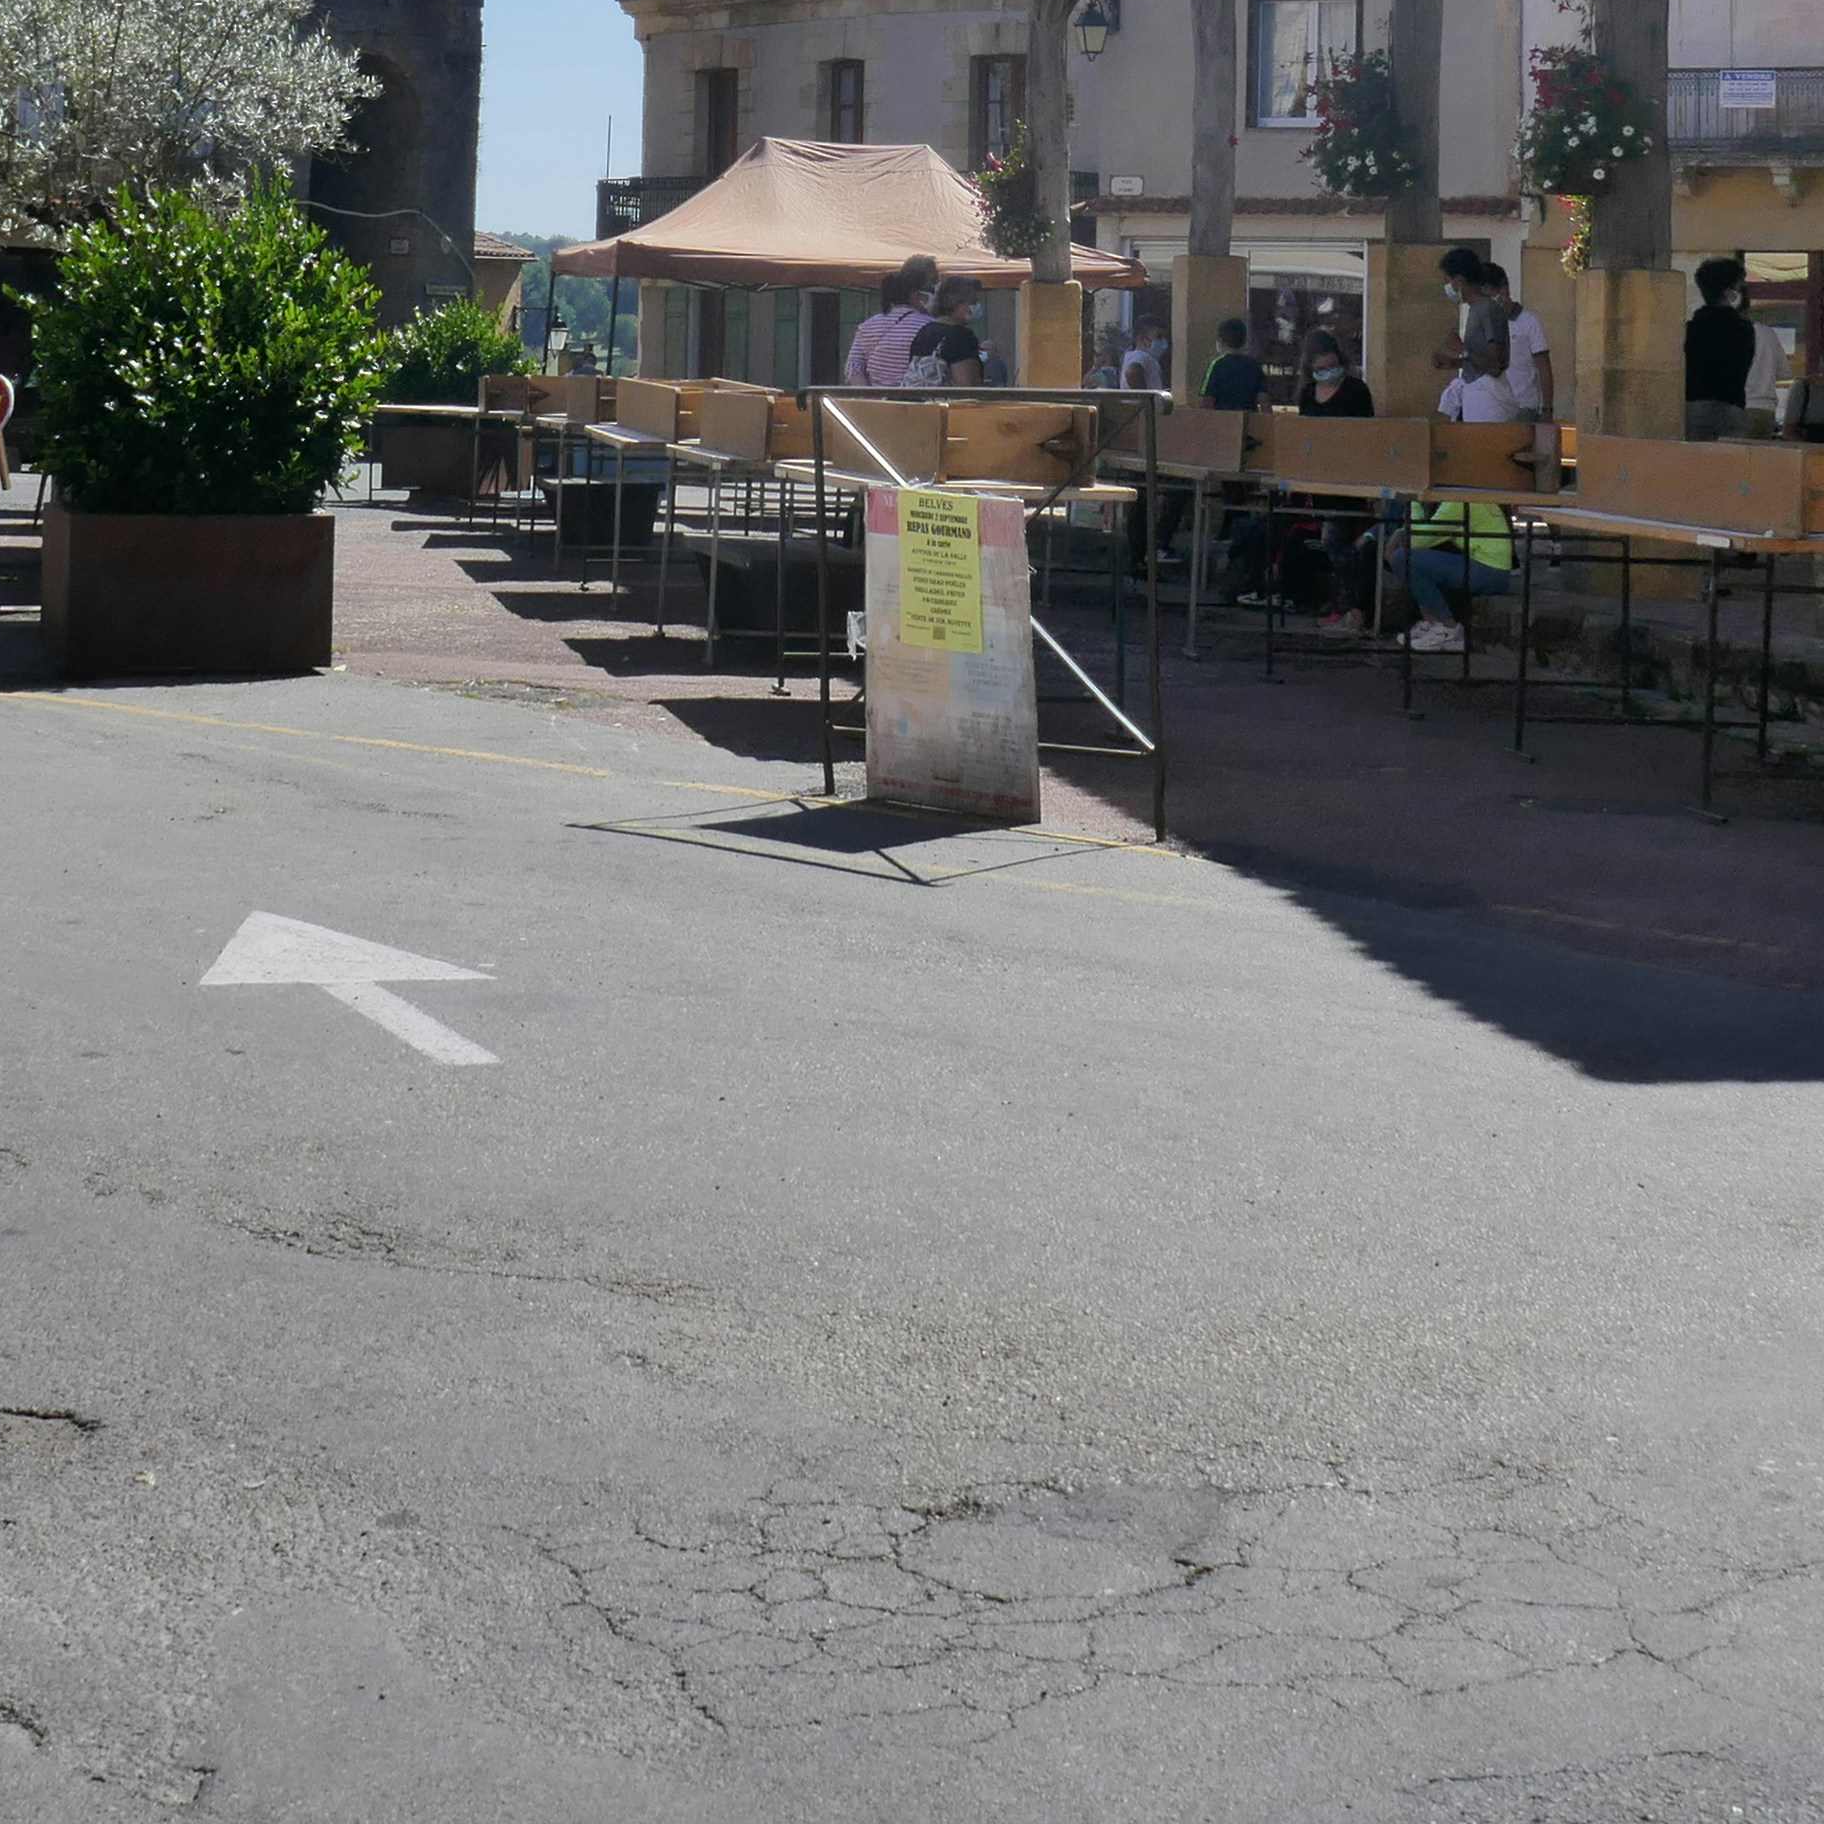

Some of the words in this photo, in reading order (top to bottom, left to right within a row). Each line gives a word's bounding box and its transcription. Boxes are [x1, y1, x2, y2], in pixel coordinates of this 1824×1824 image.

[940, 514, 967, 524] SEPTEMBRE
[907, 521, 929, 534] REPAS
[931, 524, 971, 539] GOURMAND
